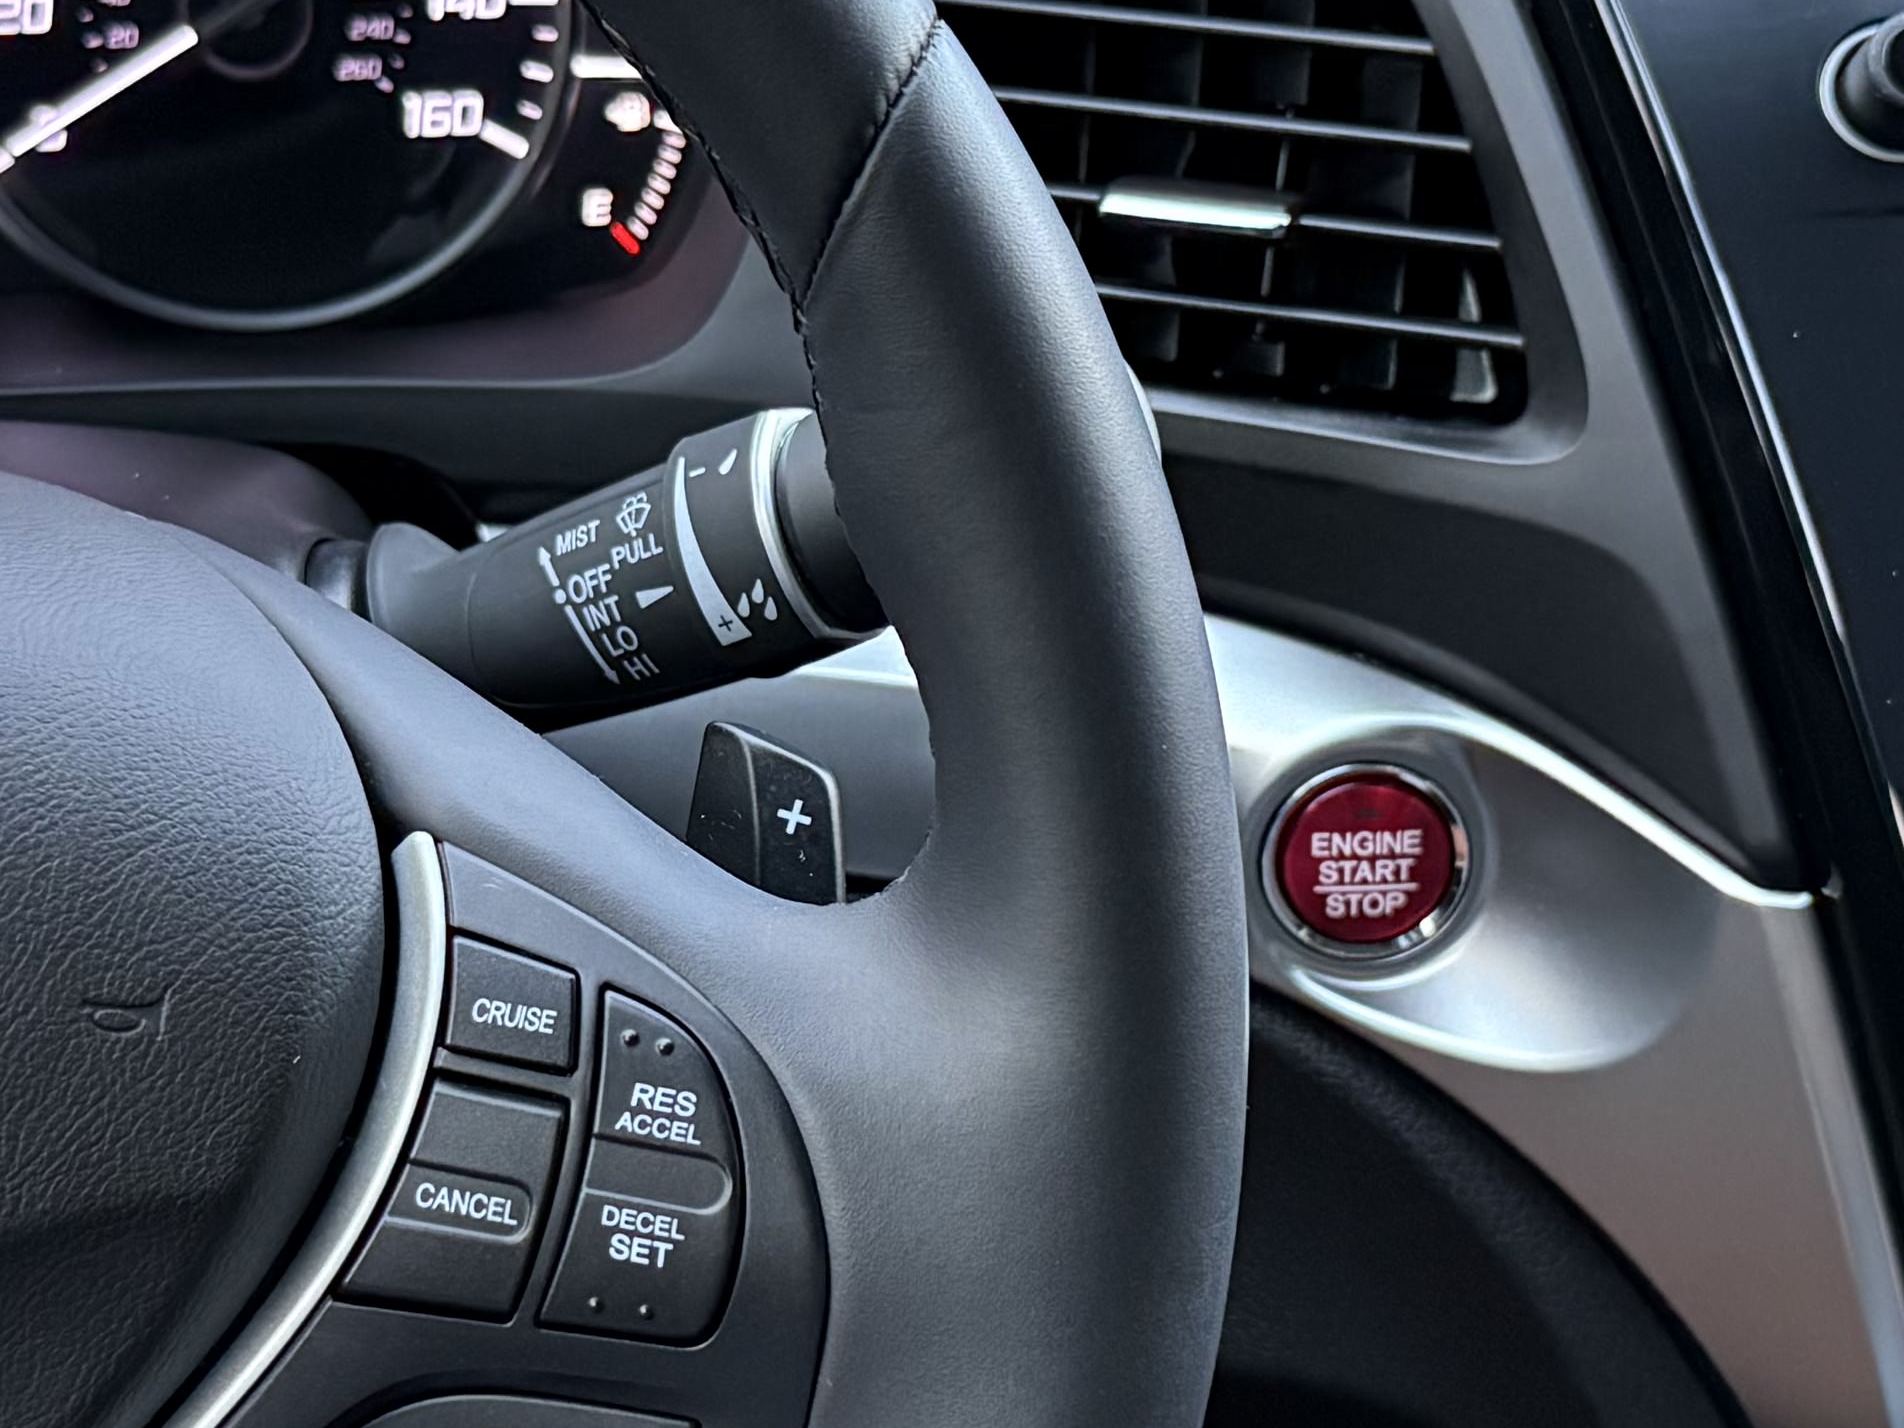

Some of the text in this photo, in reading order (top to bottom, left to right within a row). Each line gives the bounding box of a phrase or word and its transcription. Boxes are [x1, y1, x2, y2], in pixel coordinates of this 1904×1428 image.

[102, 19, 141, 51] 20
[344, 14, 395, 43] 240
[332, 54, 383, 83] 260
[400, 89, 486, 140] 160
[581, 186, 615, 228] E
[555, 519, 600, 556] MIST
[611, 534, 663, 570] PULL
[567, 563, 614, 605] OFF
[581, 595, 622, 632] INT
[601, 625, 639, 657] LO
[623, 653, 660, 681] HI
[1311, 829, 1424, 857] ENGINE
[1318, 859, 1416, 884] START
[1325, 892, 1407, 918] STOP
[470, 997, 558, 1035] CRUISE
[629, 1081, 698, 1119] RES
[613, 1109, 702, 1147] ACCEL
[413, 1181, 520, 1227] CANCEL
[600, 1203, 686, 1242] DECEL
[607, 1235, 675, 1270] SET
